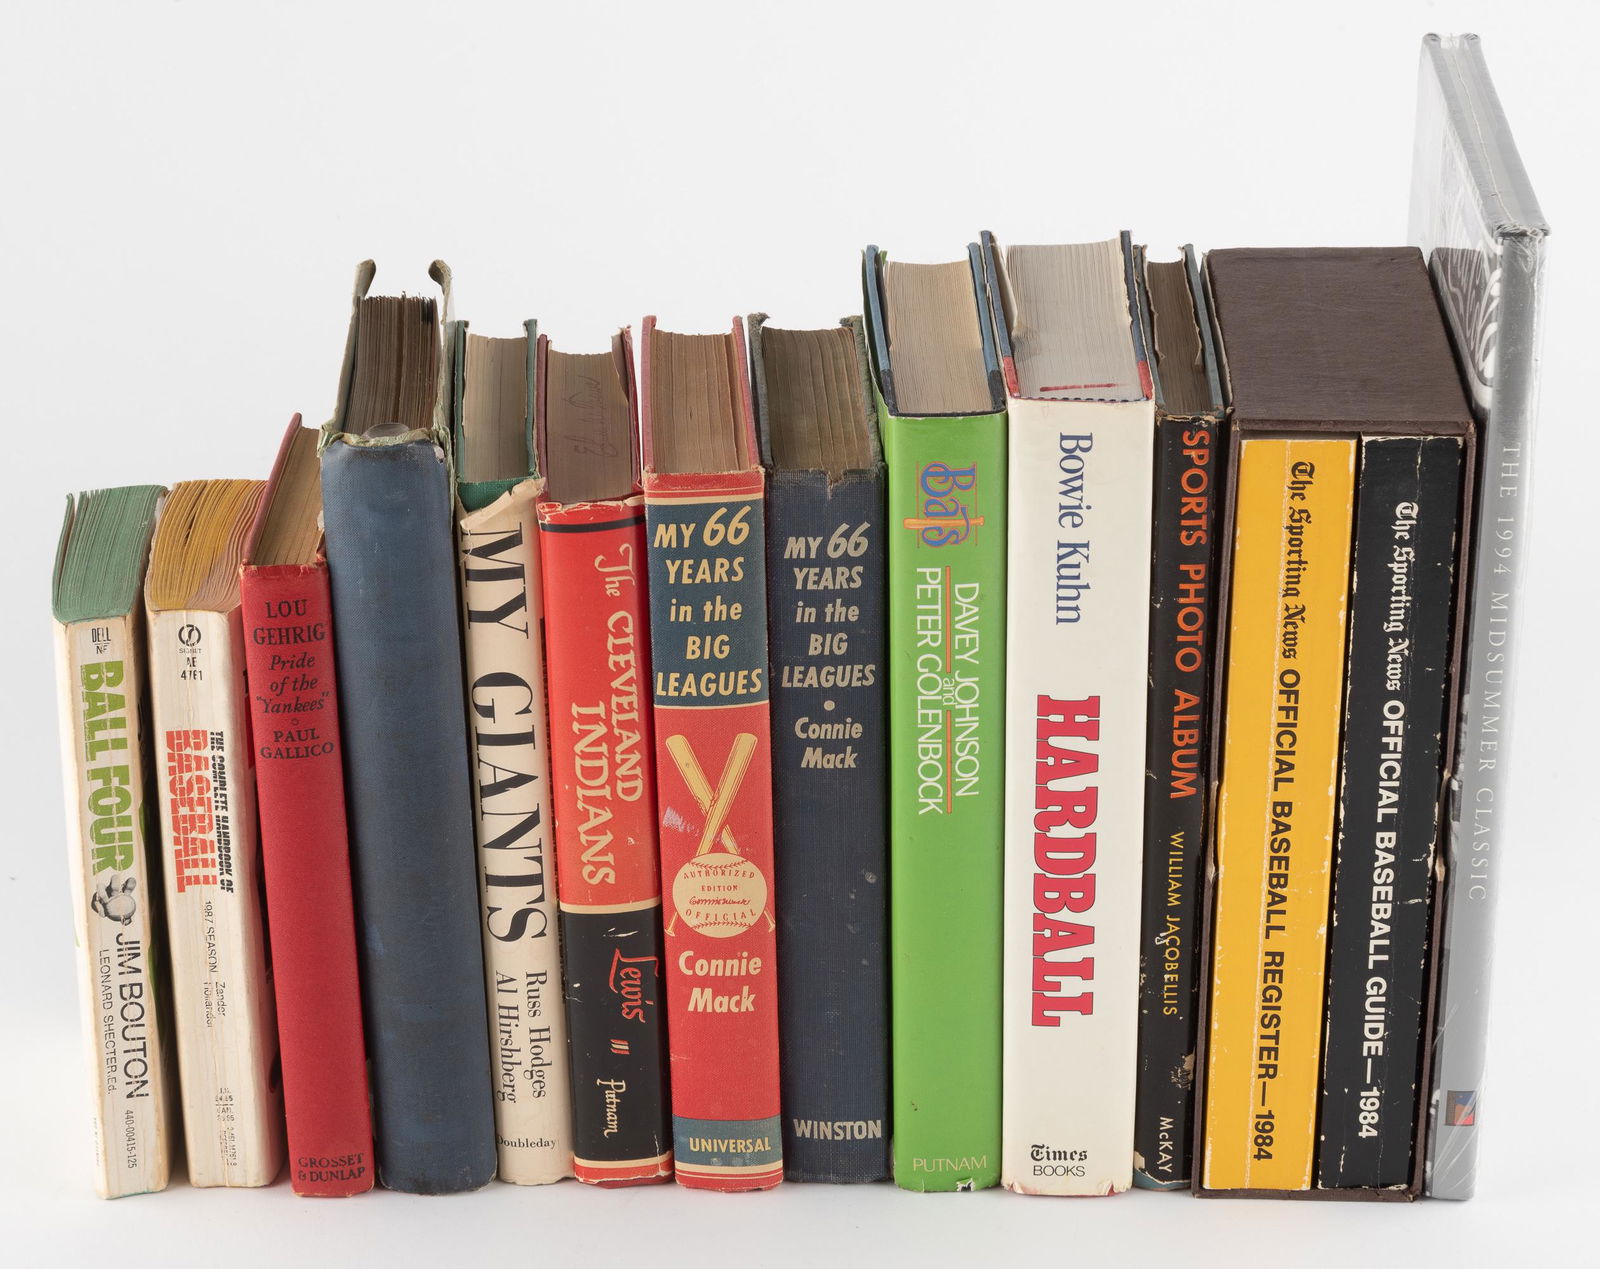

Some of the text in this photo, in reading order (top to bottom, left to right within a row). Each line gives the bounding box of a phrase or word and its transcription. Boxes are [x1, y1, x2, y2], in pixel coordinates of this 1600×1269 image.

[1290, 461, 1316, 501] The
[920, 461, 977, 549] Bats
[1390, 502, 1418, 540] The
[653, 505, 752, 548] MY 66
[783, 521, 871, 559] MY 66
[1056, 432, 1093, 625] Bowie Kuhn
[665, 556, 745, 584] YEARS
[1283, 506, 1312, 599] Sporting
[793, 565, 864, 590] YEARS
[1383, 545, 1416, 632] Sporting
[266, 600, 308, 618] LOU
[670, 595, 743, 622] in the
[795, 598, 860, 623] in the
[1169, 430, 1210, 799] SPORTS PHOTO ALBUM
[91, 626, 111, 642] DELL
[253, 623, 326, 646] GEHRIG
[686, 634, 730, 660] BIG
[808, 632, 848, 656] BIG
[1281, 602, 1307, 659] News
[269, 652, 316, 671] Pride
[594, 542, 644, 802] The CLEVELAND
[781, 664, 876, 688] LEAGUES
[1386, 637, 1410, 691] News
[1469, 447, 1520, 901] THE 1994 MIDSUMMER CLASSIC
[269, 676, 290, 697] of
[292, 673, 319, 691] the
[656, 668, 763, 697] LEAGUES
[916, 567, 943, 815] PETER GOLENBOCK
[942, 677, 956, 707] and
[954, 582, 980, 797] DAVEY JOHNSON
[210, 731, 225, 752] THE
[273, 728, 320, 743] PAUL
[460, 521, 548, 943] MY GIANTS
[794, 717, 863, 739] Connie
[1272, 668, 1301, 792] OFFICIAL
[80, 659, 135, 878] BALL FOUR
[260, 742, 335, 760] GALLICO
[801, 746, 858, 769] Mack
[1377, 700, 1405, 822] OFFICIAL
[211, 754, 228, 812] COMPLETE
[571, 702, 616, 885] INDIANS
[165, 730, 218, 893] BASEBALL
[683, 869, 755, 879] AUTHORIZED
[1031, 694, 1101, 1027] HARDBALL
[1265, 801, 1293, 939] BASEBALL
[685, 909, 756, 921] OFFICIAL
[1368, 831, 1397, 969] BASEBALL
[1163, 831, 1185, 1016] WILLIAM JACOBELLIS
[99, 949, 113, 1010] LEONARD
[678, 951, 762, 977] Connie
[609, 948, 659, 1024] Lewis
[687, 986, 756, 1013] Mack
[116, 932, 149, 1099] JIM BOUTON
[523, 969, 553, 1099] Russ Hodges
[496, 970, 520, 1104] Al Hirshberg
[596, 1079, 627, 1139] Putnam
[124, 1110, 137, 1169] 440-00415-125
[689, 1136, 771, 1153] UNIVERSAL
[793, 1118, 882, 1141] WINSTON
[1158, 1116, 1174, 1174] McKAY
[298, 1153, 364, 1168] GROSSET
[913, 1155, 987, 1172] PUTNAM
[1030, 1144, 1088, 1161] Times
[1033, 1165, 1086, 1177] BOOKS
[310, 1167, 365, 1182] DUNLAP
